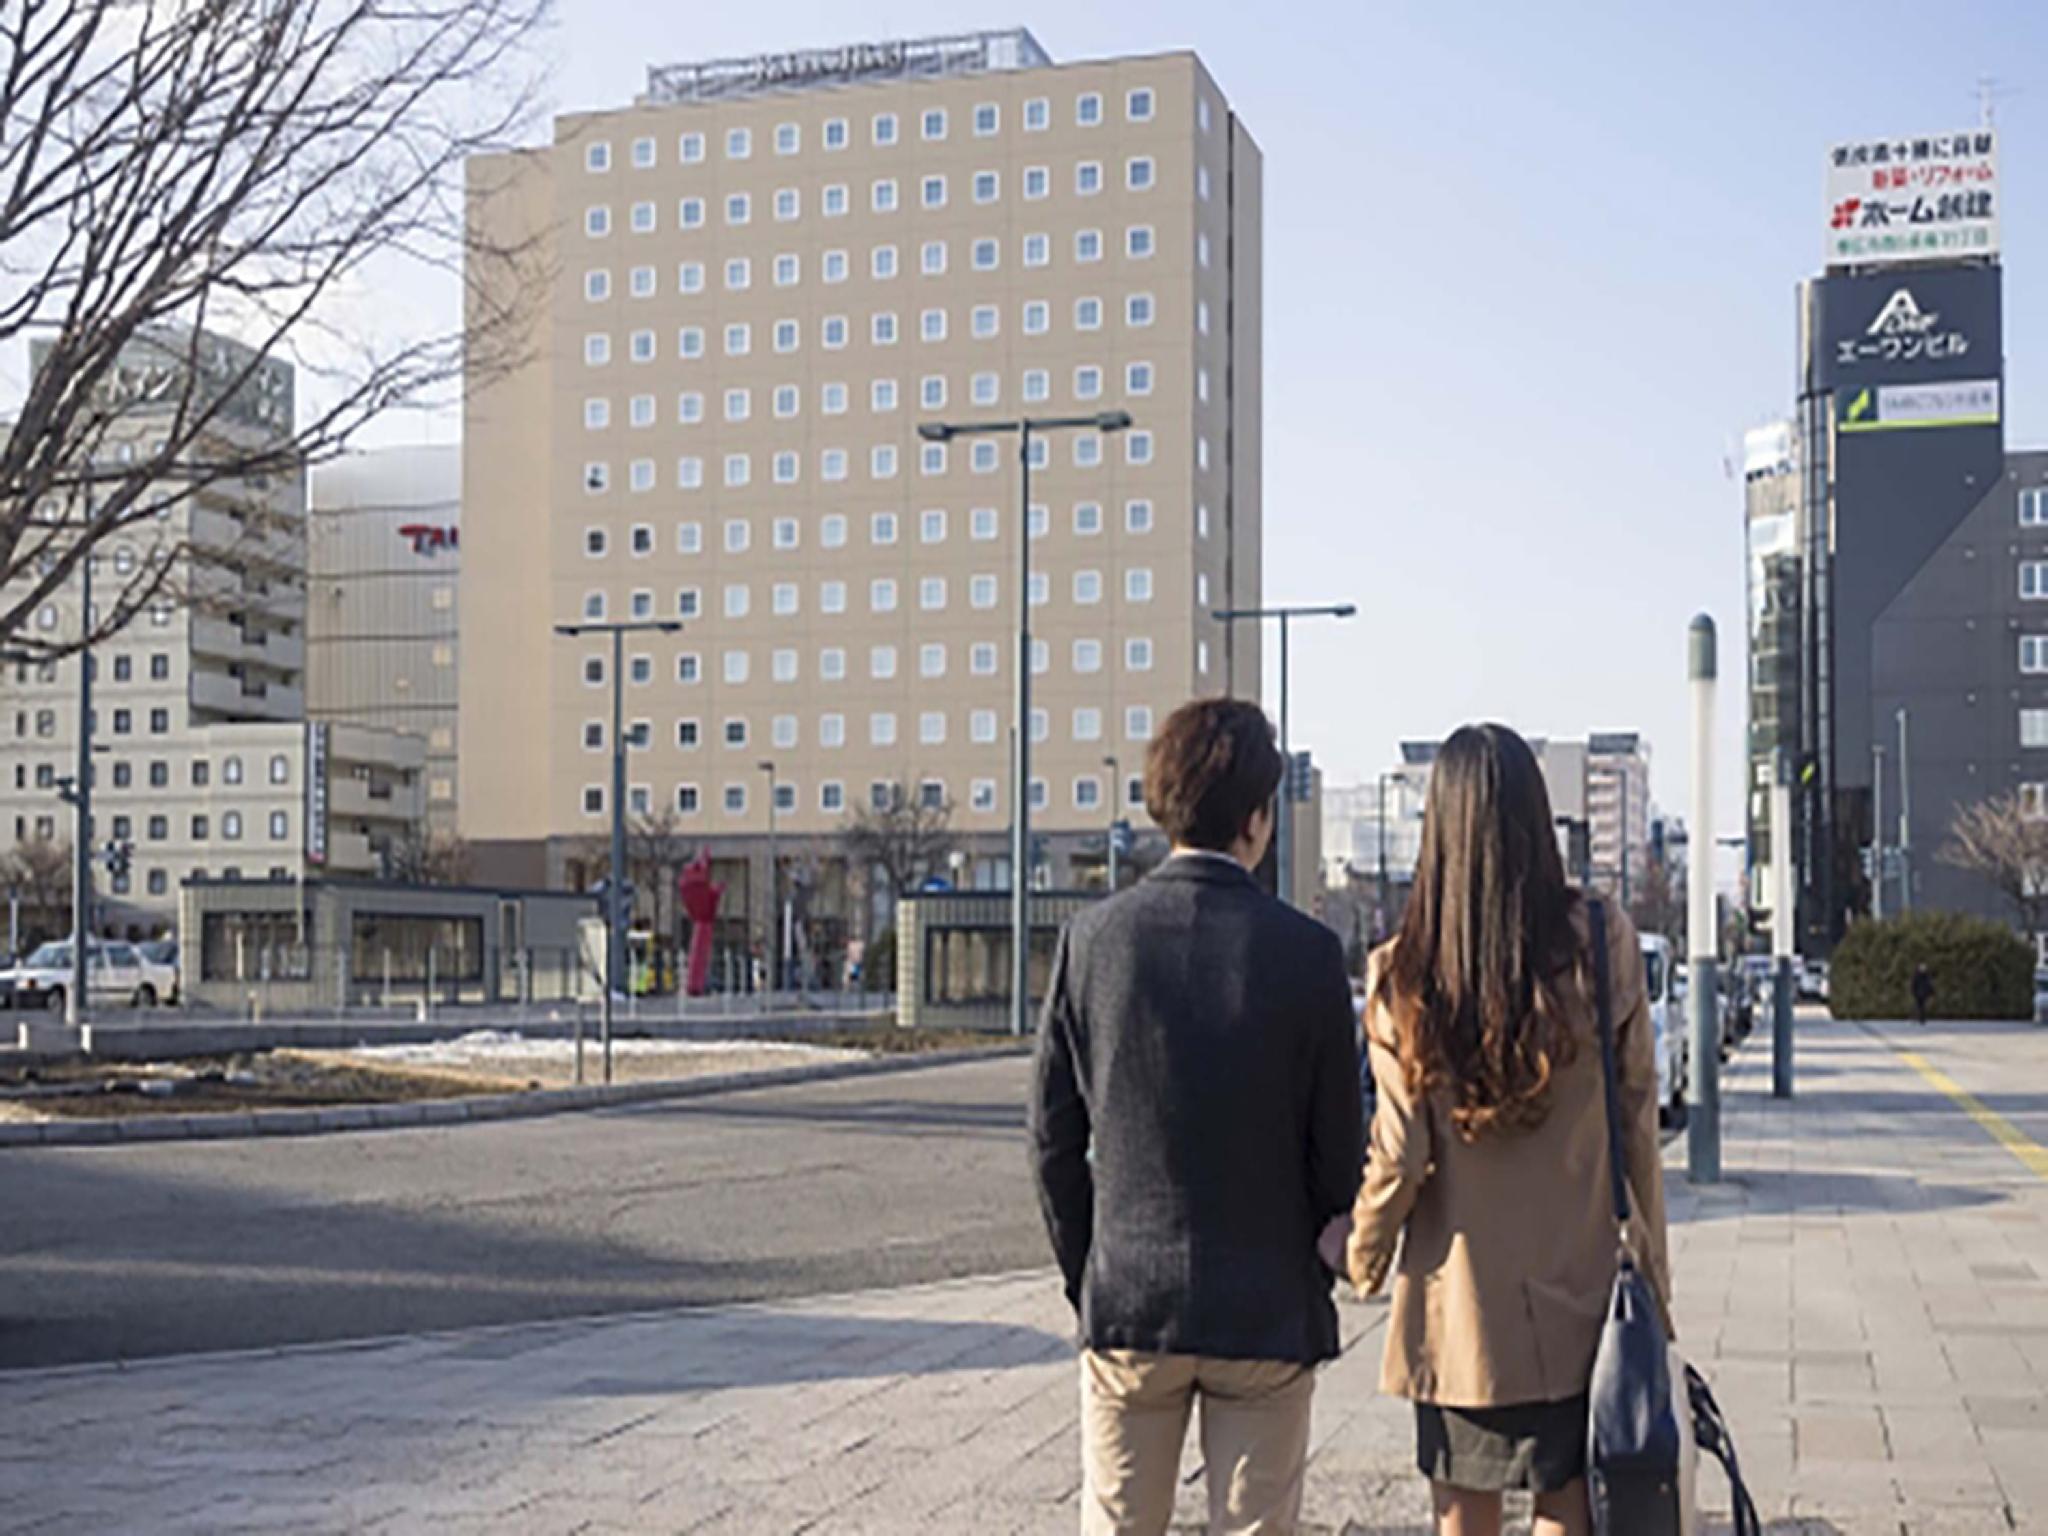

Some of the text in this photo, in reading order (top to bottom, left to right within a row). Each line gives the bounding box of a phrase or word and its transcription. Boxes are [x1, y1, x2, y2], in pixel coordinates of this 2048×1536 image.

[1837, 332, 1970, 363] エーワンビル
